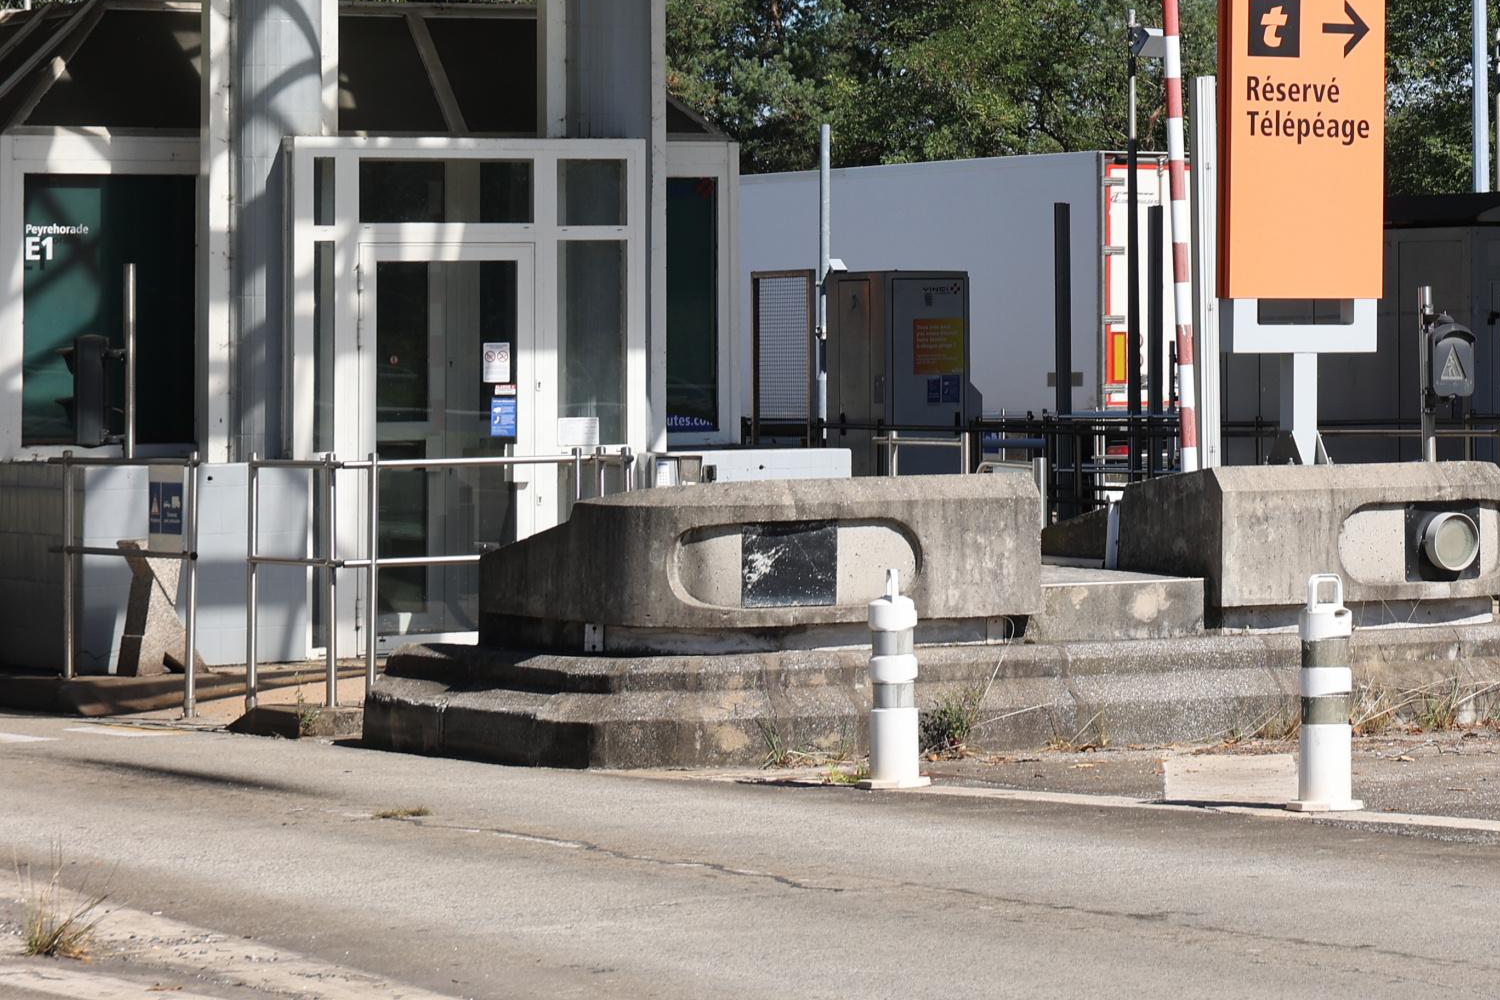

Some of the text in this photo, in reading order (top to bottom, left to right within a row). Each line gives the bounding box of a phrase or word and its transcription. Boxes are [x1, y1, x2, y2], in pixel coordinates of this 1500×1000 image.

[1260, 5, 1288, 48] t
[1246, 75, 1340, 103] Réservé
[1246, 109, 1370, 146] Télépéage
[25, 223, 89, 237] Peyrehorade
[25, 236, 54, 261] E1
